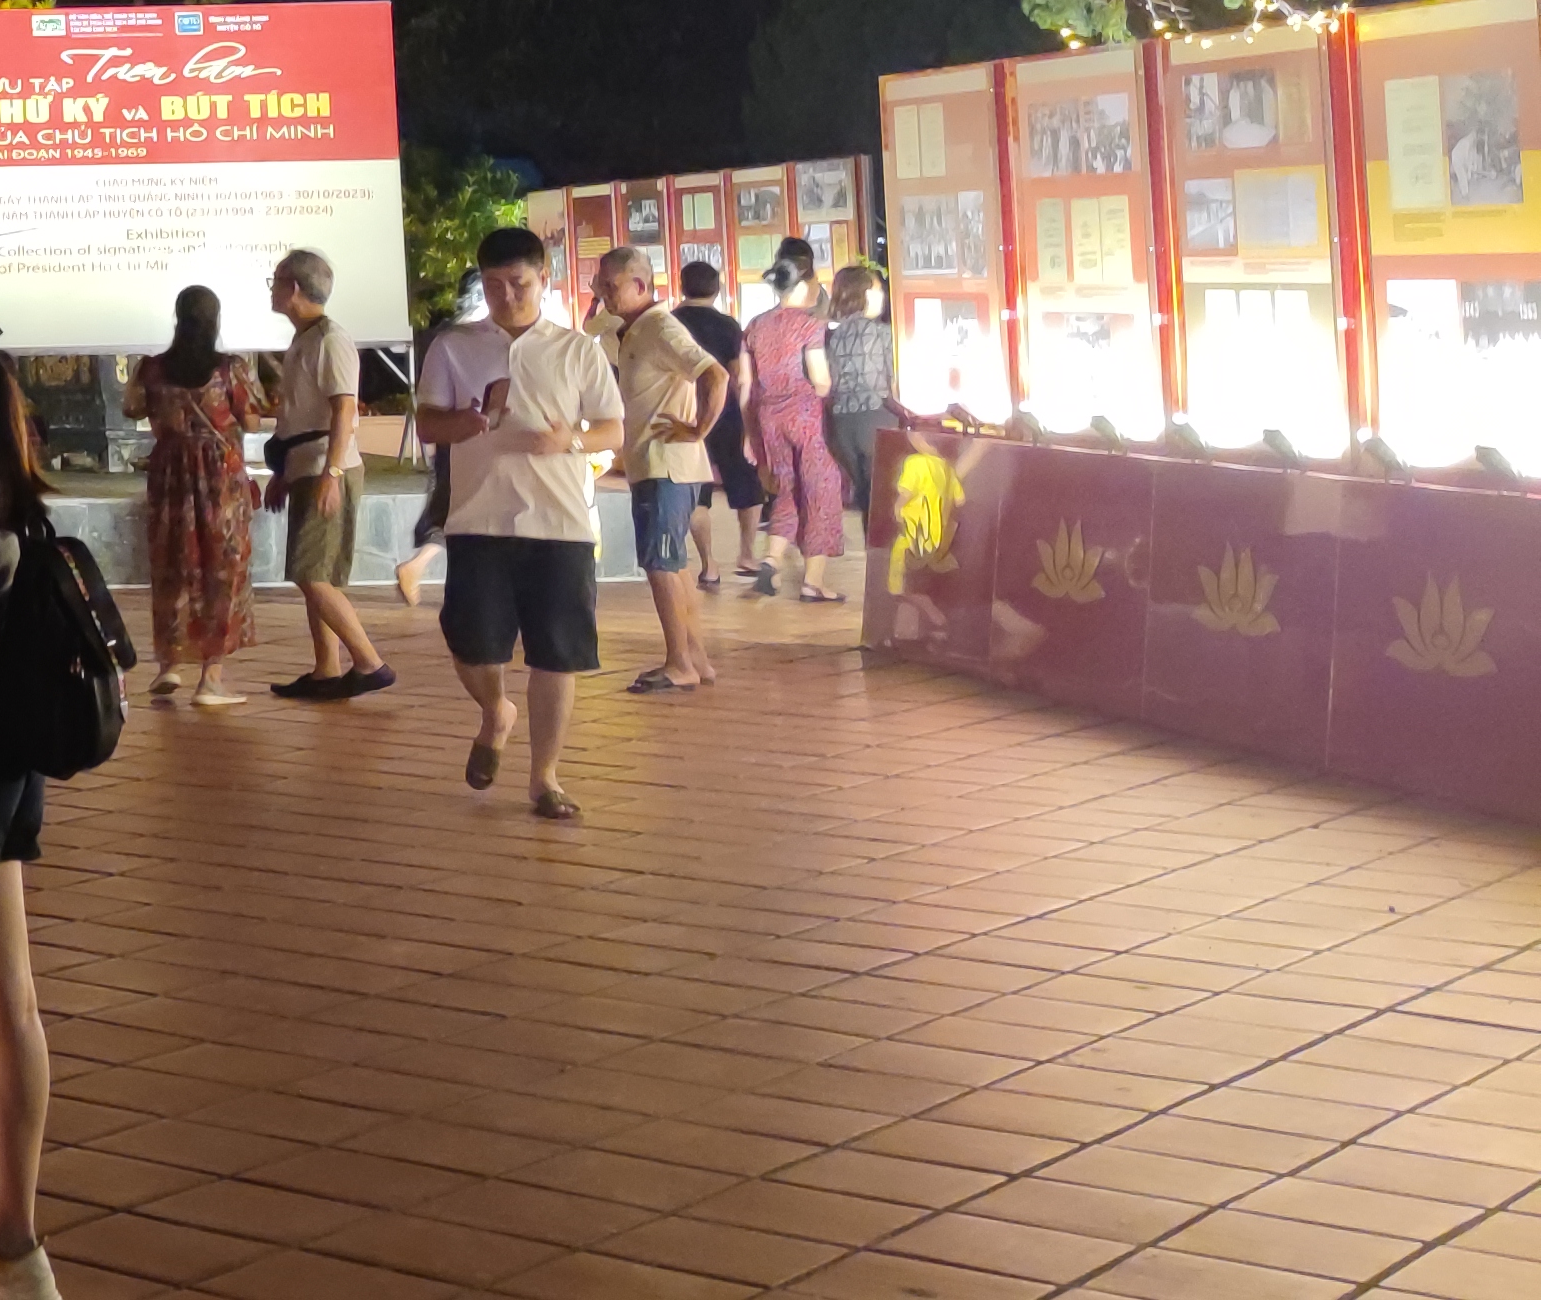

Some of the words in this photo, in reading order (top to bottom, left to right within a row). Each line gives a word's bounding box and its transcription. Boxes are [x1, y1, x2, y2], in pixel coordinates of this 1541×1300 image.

[62, 93, 110, 123] KÝ
[160, 91, 233, 121] BÚT
[243, 89, 331, 119] TÍCH
[36, 123, 92, 145] CHỦ
[215, 122, 258, 141] CHÍ
[266, 123, 335, 140] MINH
[65, 147, 147, 161] 1945-1969
[126, 227, 206, 241] Exhibition
[77, 244, 91, 256] of
[17, 261, 86, 274] President
